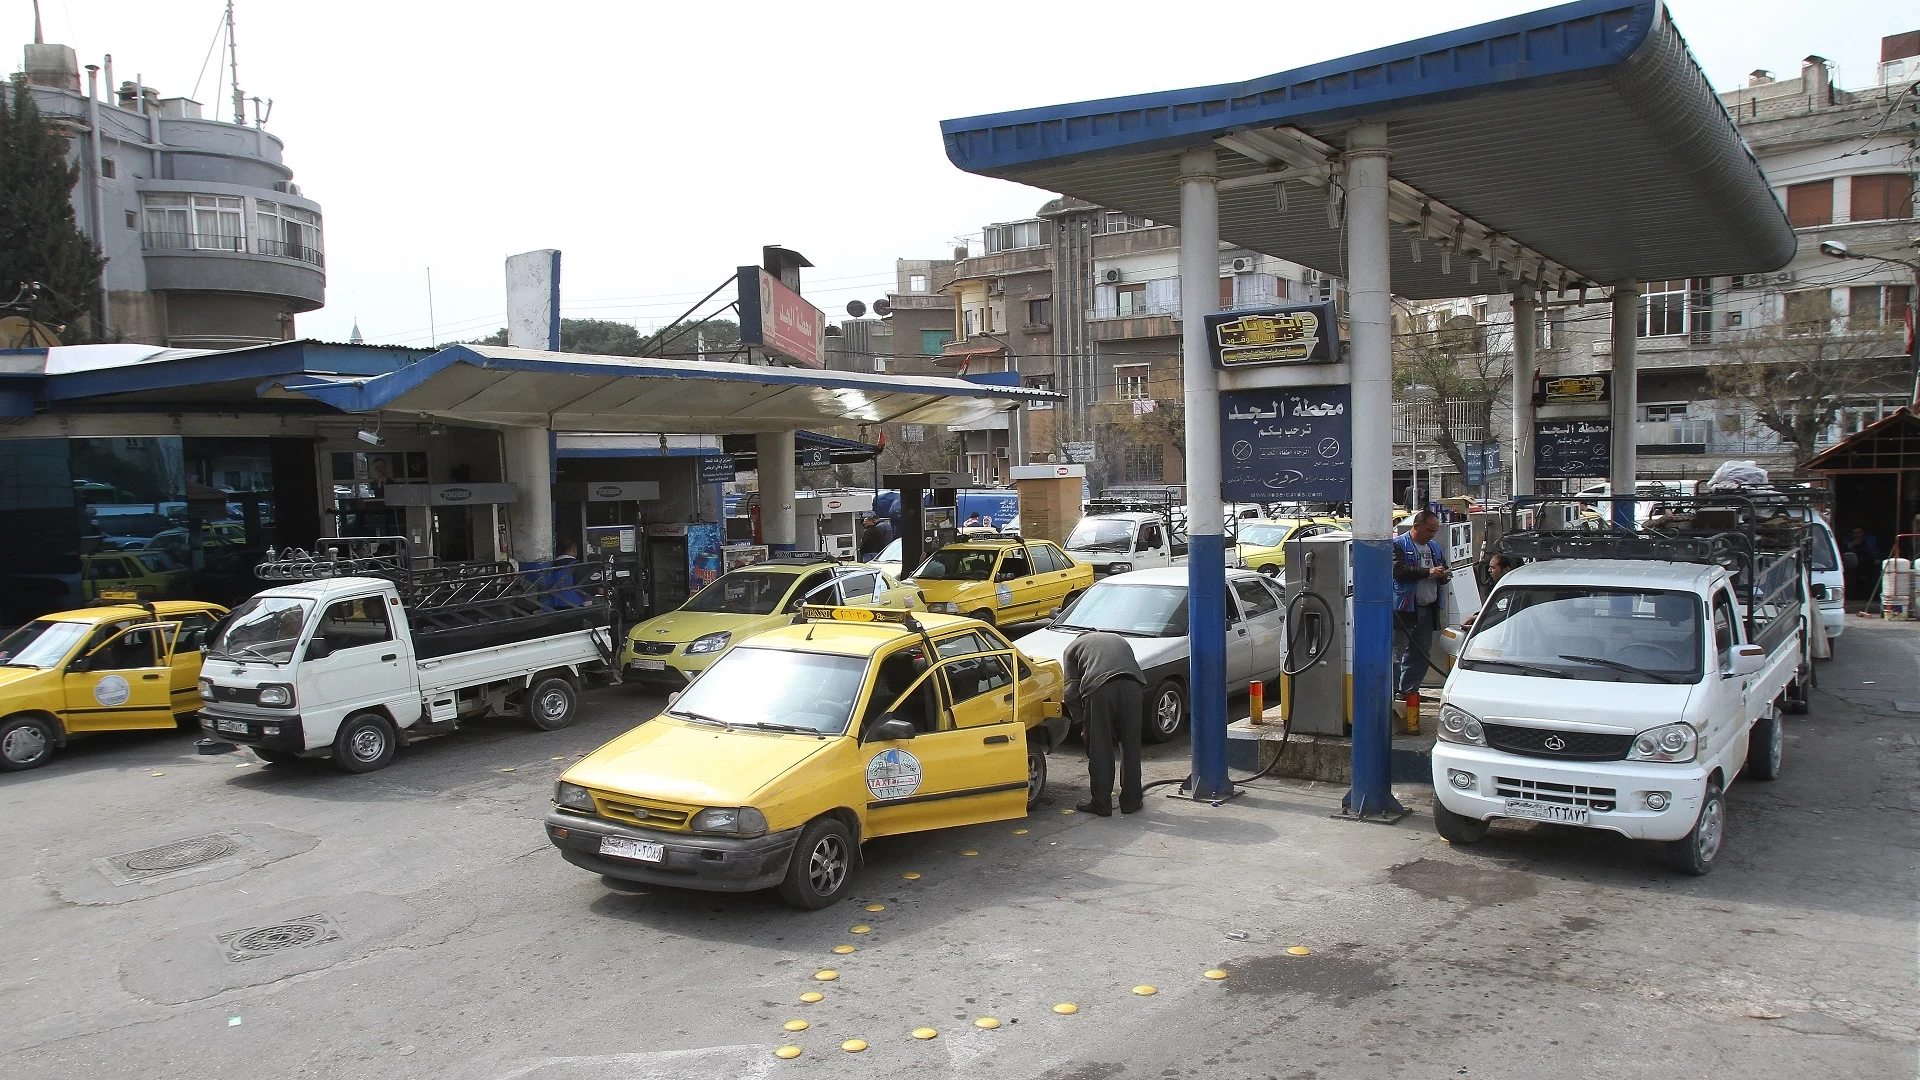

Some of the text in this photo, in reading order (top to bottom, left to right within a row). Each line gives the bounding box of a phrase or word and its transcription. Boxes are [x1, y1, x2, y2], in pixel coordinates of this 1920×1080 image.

[1228, 396, 1344, 425] محطة الجد
[1258, 423, 1312, 438] ترحب بكم
[1539, 422, 1609, 437] محطة الجد
[1453, 547, 1458, 559] 3
[807, 609, 831, 619] TAXI
[870, 779, 890, 788] TAXI
